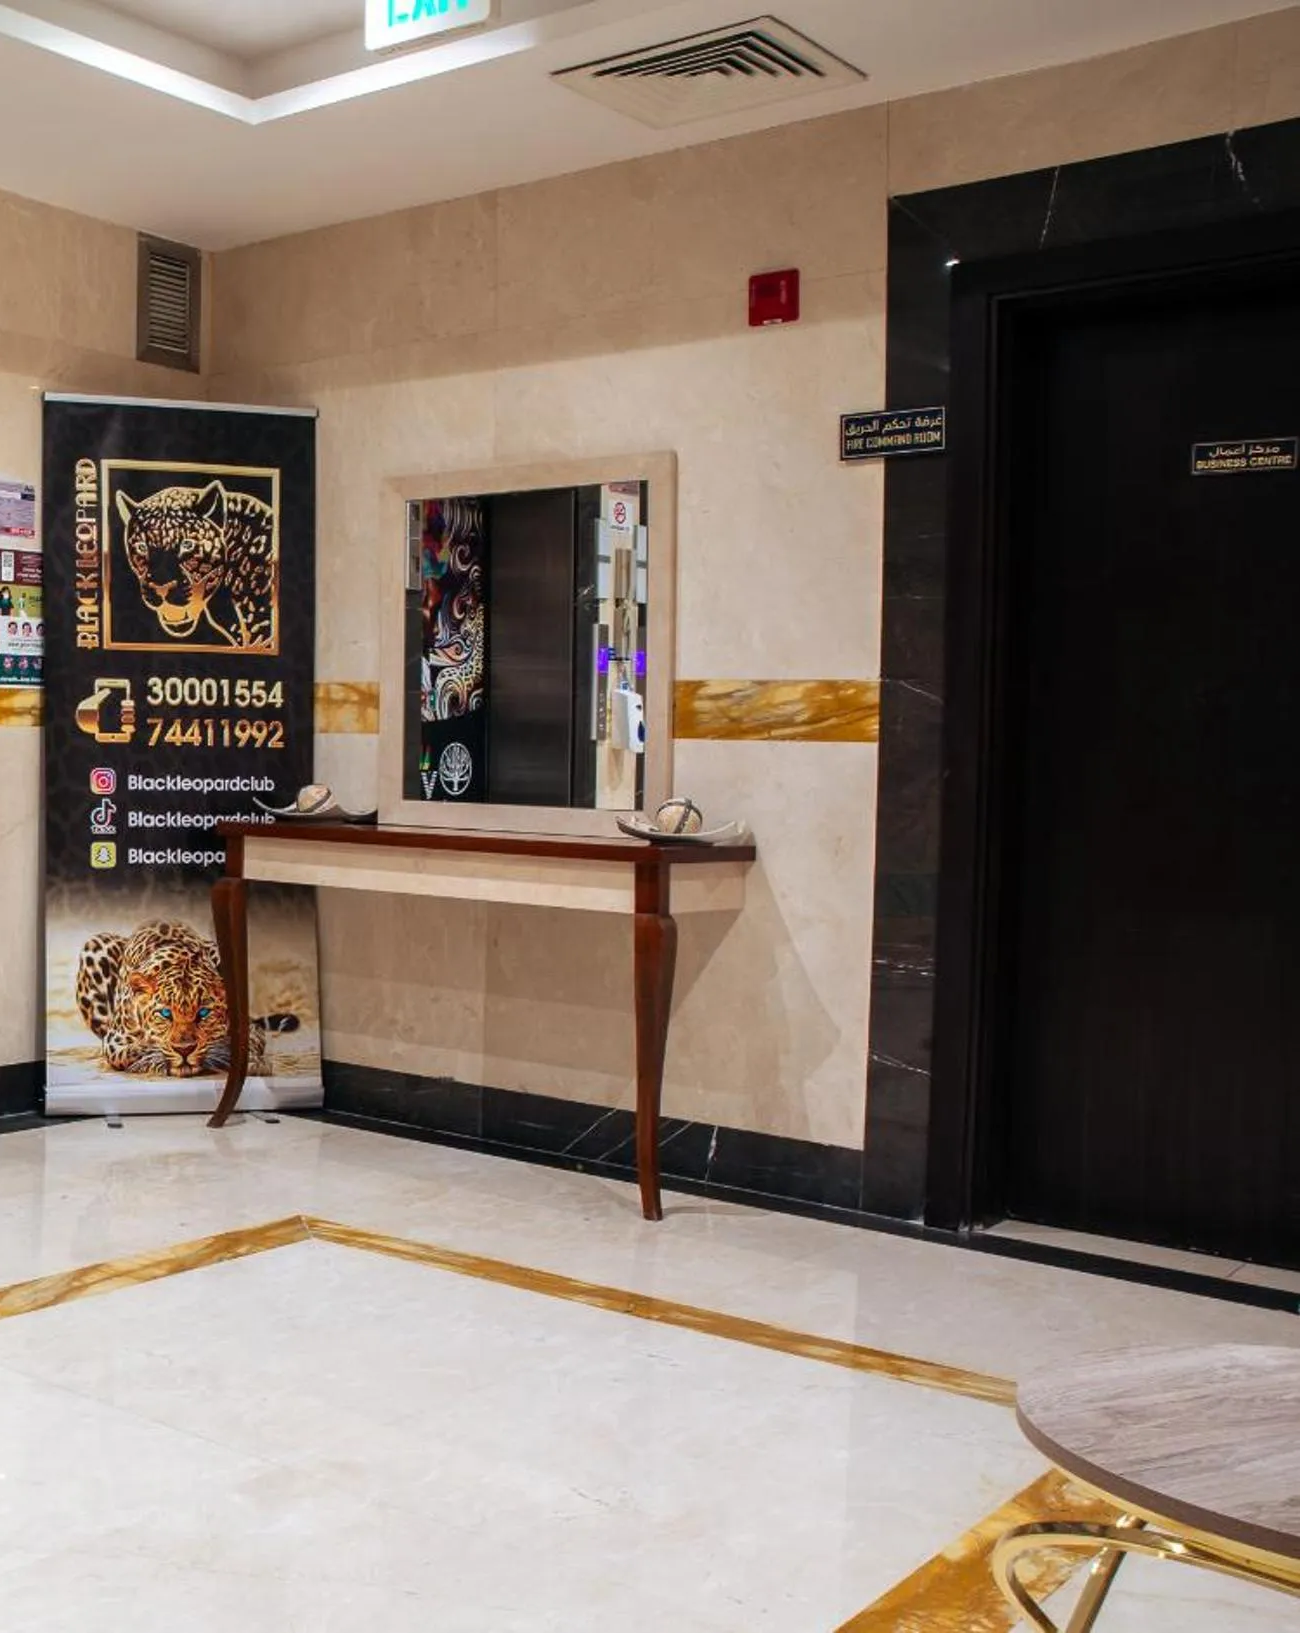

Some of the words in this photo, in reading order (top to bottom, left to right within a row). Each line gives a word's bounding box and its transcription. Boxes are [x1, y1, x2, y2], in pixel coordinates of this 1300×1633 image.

[847, 438, 864, 450] FIRE
[866, 433, 912, 448] COMMAND
[913, 431, 941, 445] ROOM
[1195, 457, 1247, 470] BUSINESS
[1249, 455, 1292, 467] CENTRE
[75, 458, 98, 569] LEOPARD
[75, 572, 100, 649] BLACK
[147, 677, 284, 708] 30001554
[147, 718, 284, 748] 74411992
[127, 775, 275, 794] Blackleopardclub
[127, 848, 226, 866] Blackleopa
